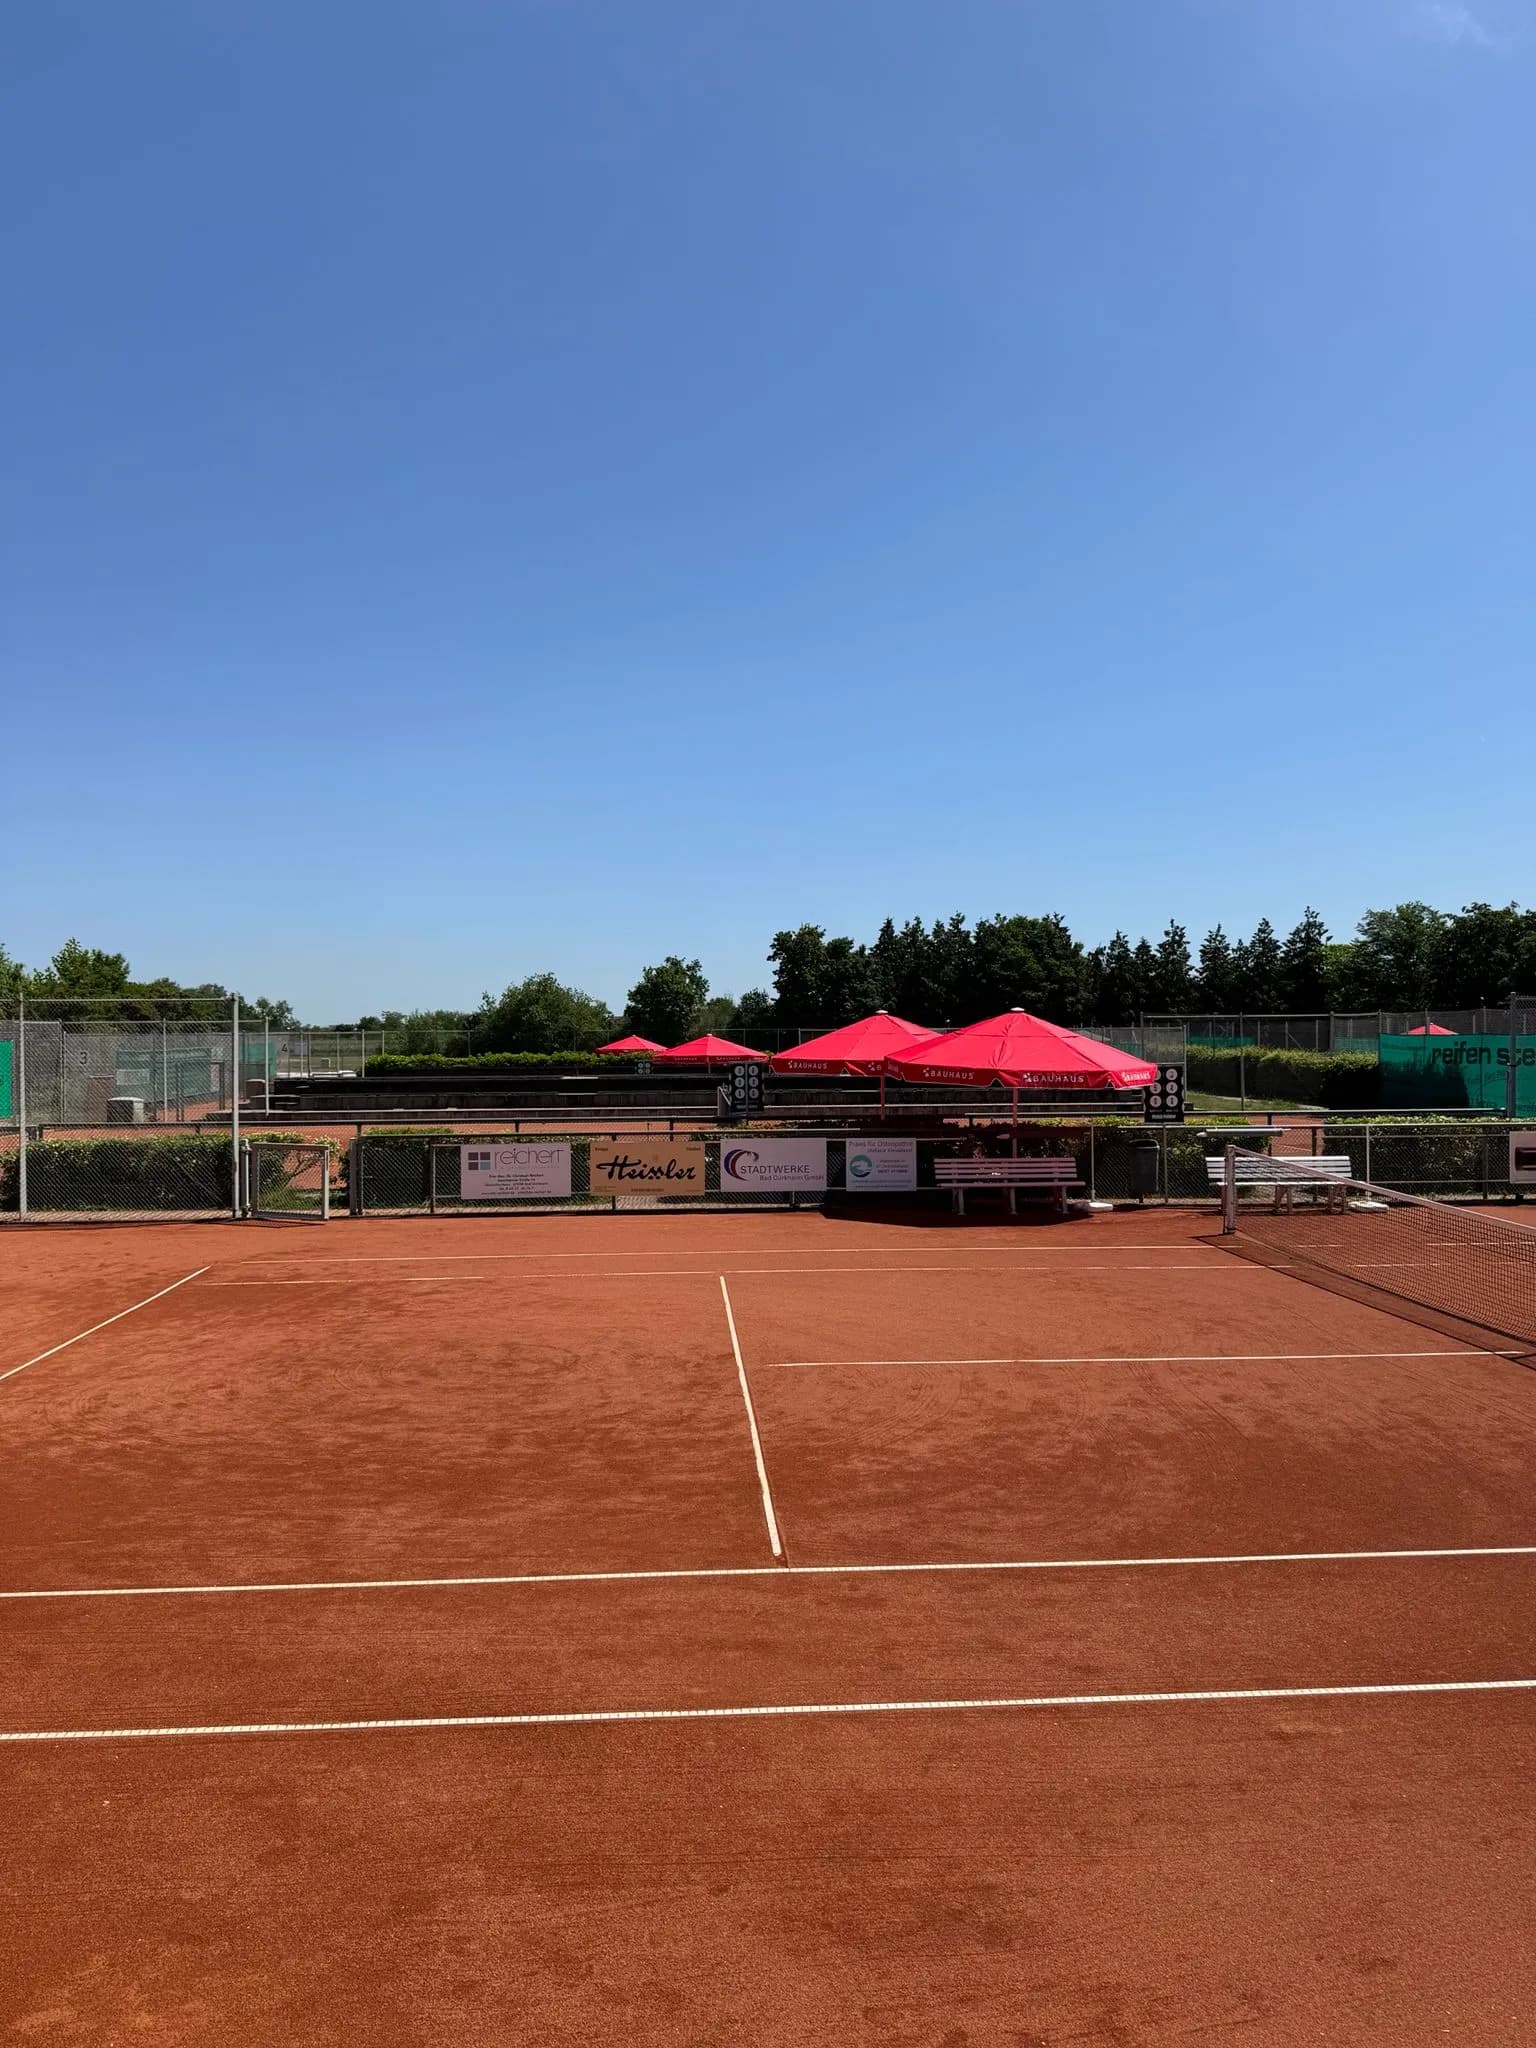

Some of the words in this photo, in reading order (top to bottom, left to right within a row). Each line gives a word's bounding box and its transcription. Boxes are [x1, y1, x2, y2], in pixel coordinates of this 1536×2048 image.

[80, 1051, 88, 1065] 3
[1432, 1041, 1491, 1065] reifen
[793, 1062, 828, 1070] BAUHAUS
[930, 1069, 975, 1080] BAUHAUS
[1032, 1073, 1085, 1083] BAUHAUS
[494, 1147, 565, 1169] reichert
[595, 1155, 697, 1180] Heissler
[740, 1164, 810, 1174] STADTWERKE
